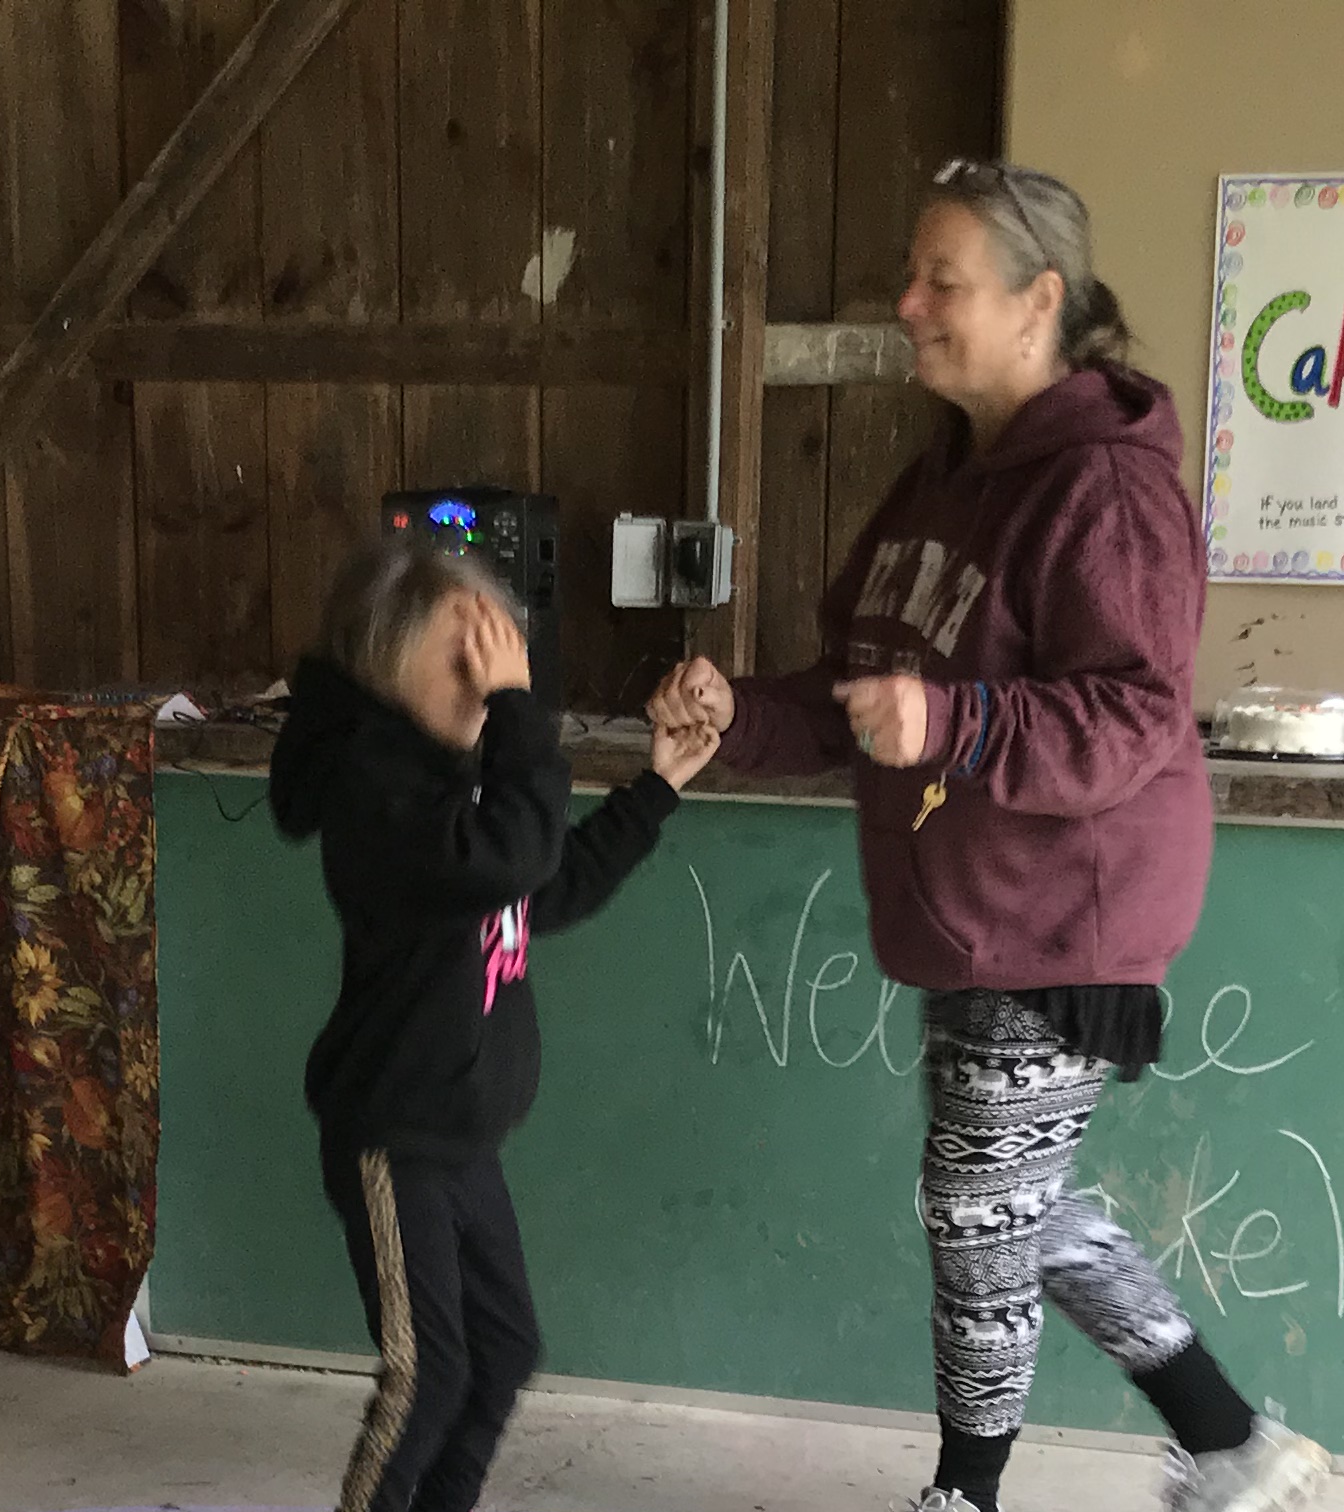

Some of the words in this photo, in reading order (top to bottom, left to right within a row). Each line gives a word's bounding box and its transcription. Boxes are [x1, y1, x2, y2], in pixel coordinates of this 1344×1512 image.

[1260, 495, 1274, 510] If
[1277, 499, 1303, 516] you
[1310, 495, 1338, 510] land
[1259, 516, 1282, 530] the
[1289, 513, 1327, 528] music
